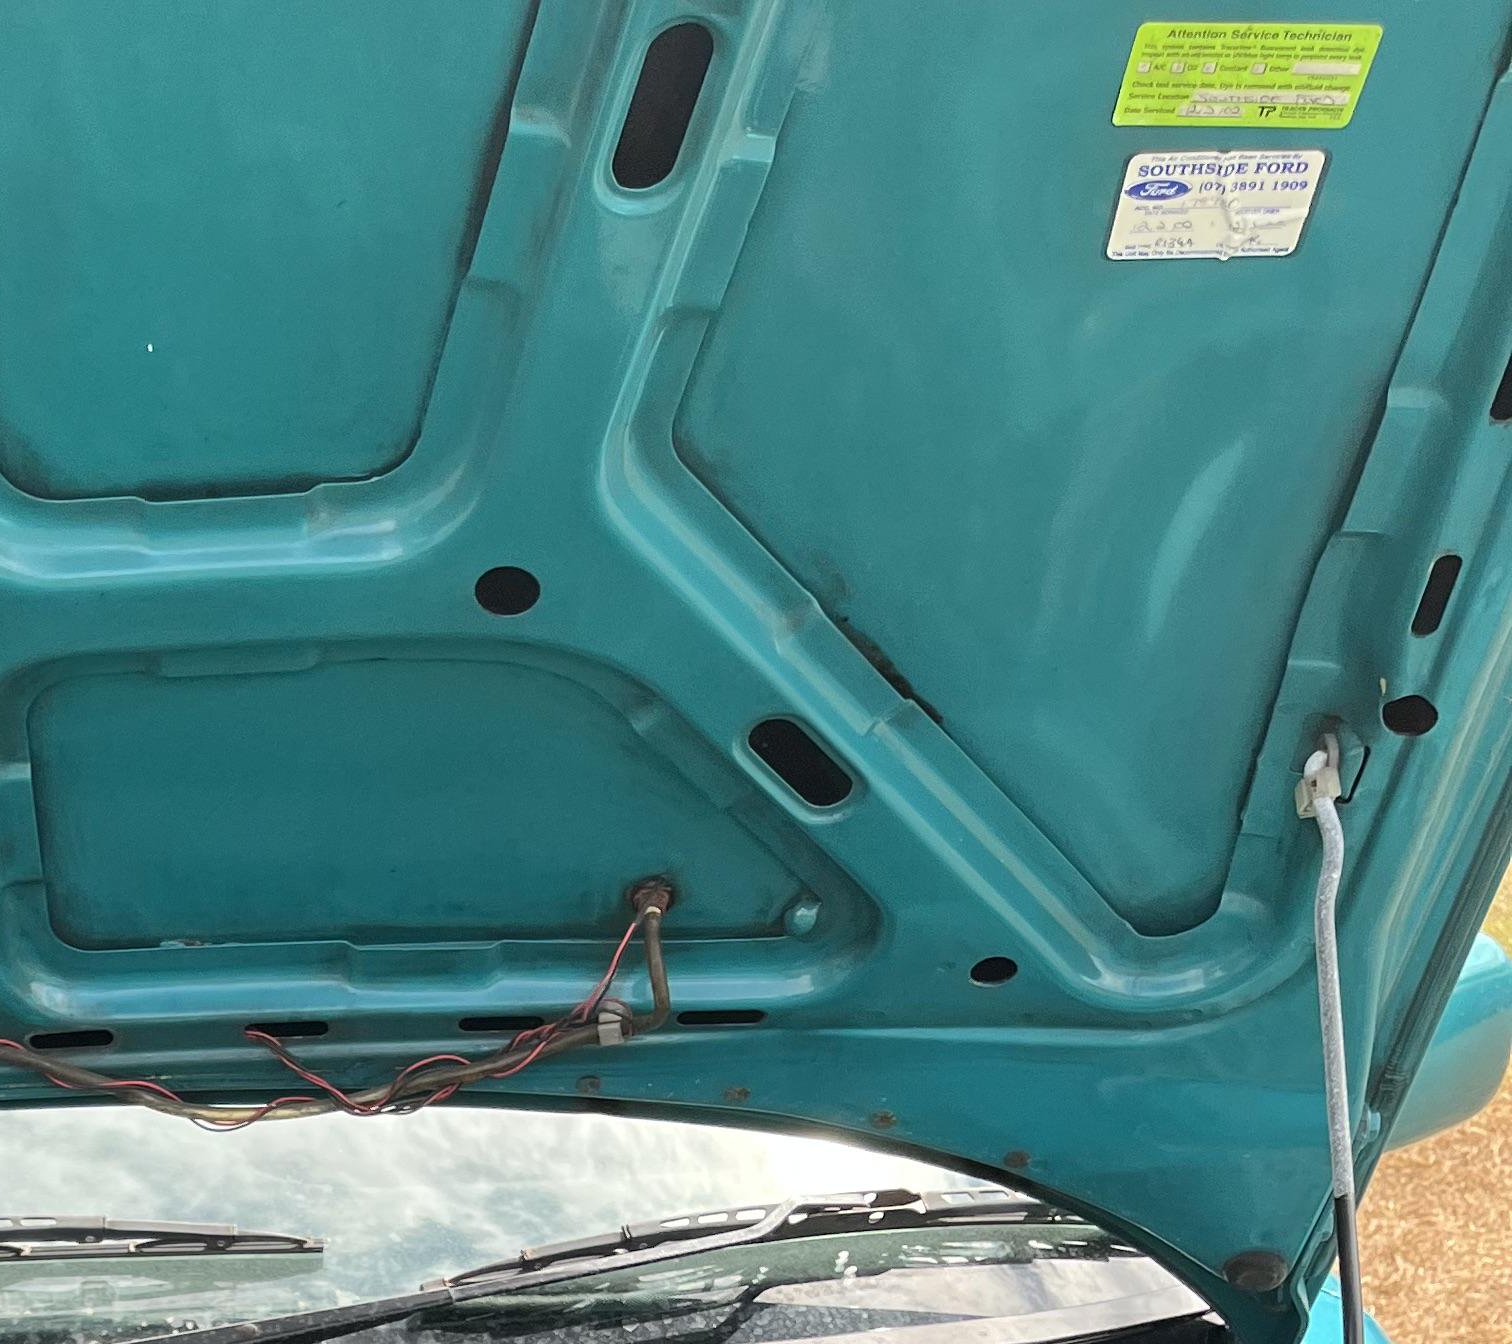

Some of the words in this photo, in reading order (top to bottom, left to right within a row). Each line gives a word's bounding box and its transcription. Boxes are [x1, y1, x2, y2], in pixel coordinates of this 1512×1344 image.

[1168, 29, 1227, 39] Attention
[1231, 29, 1279, 40] Service
[1283, 30, 1352, 42] Technician
[1138, 162, 1249, 178] SOUTHSIDE
[1254, 161, 1309, 174] FORD
[1199, 180, 1226, 195] (07)
[1230, 180, 1265, 192] 3891
[1272, 180, 1308, 191] 1909
